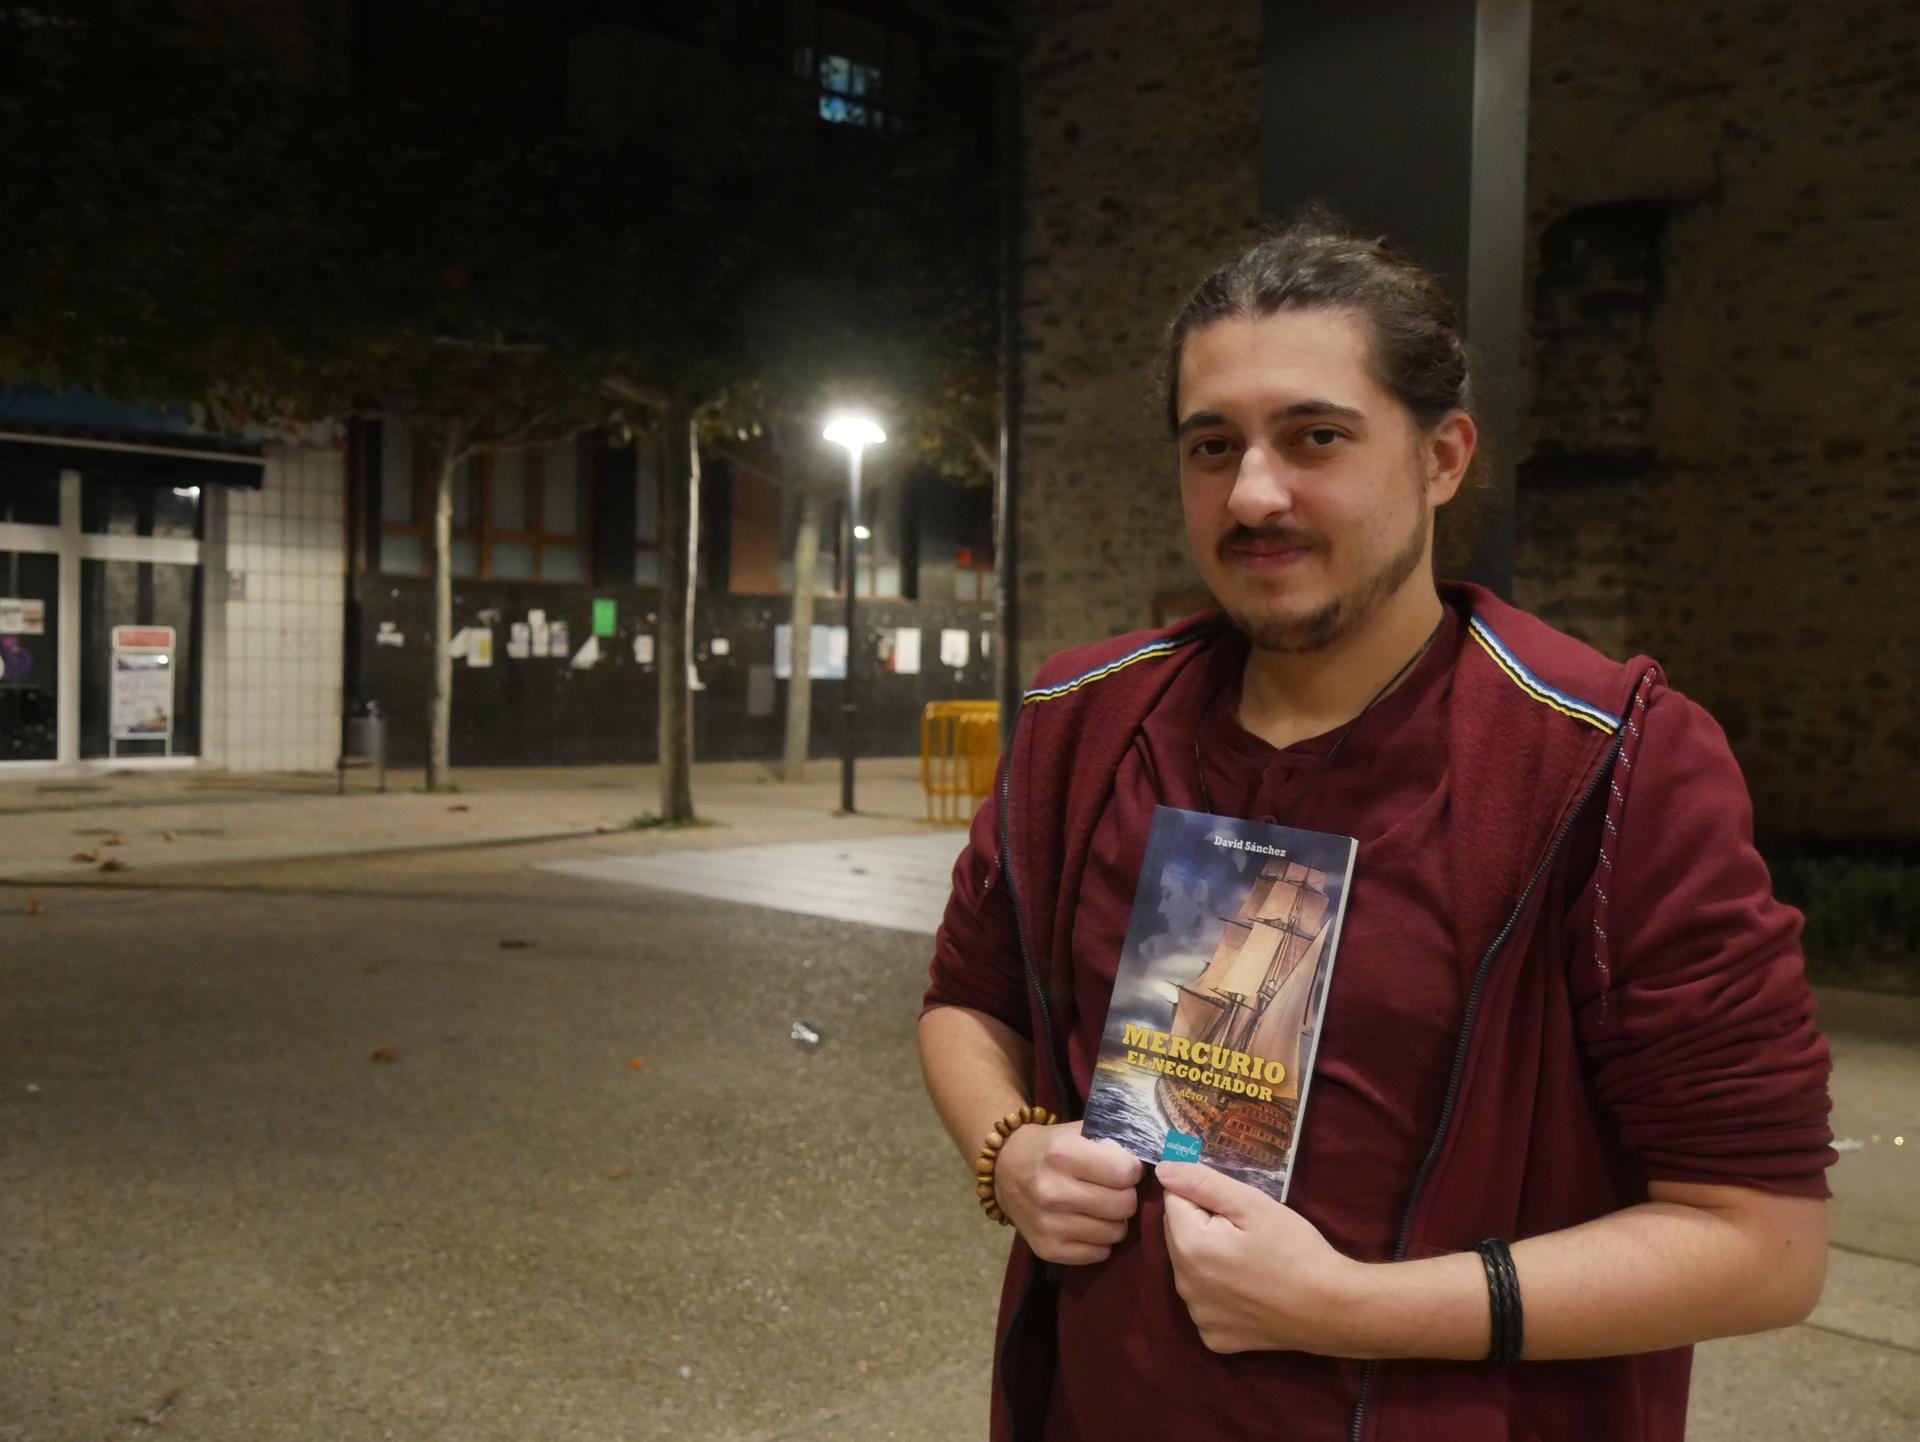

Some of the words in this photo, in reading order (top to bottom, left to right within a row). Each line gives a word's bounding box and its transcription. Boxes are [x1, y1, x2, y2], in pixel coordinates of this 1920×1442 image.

[1214, 836, 1244, 849] David
[1245, 842, 1287, 857] Sánchez
[1122, 1024, 1286, 1084] MERCURIO
[1127, 1050, 1148, 1067] EL
[1152, 1057, 1273, 1102] NEGOCIADOR
